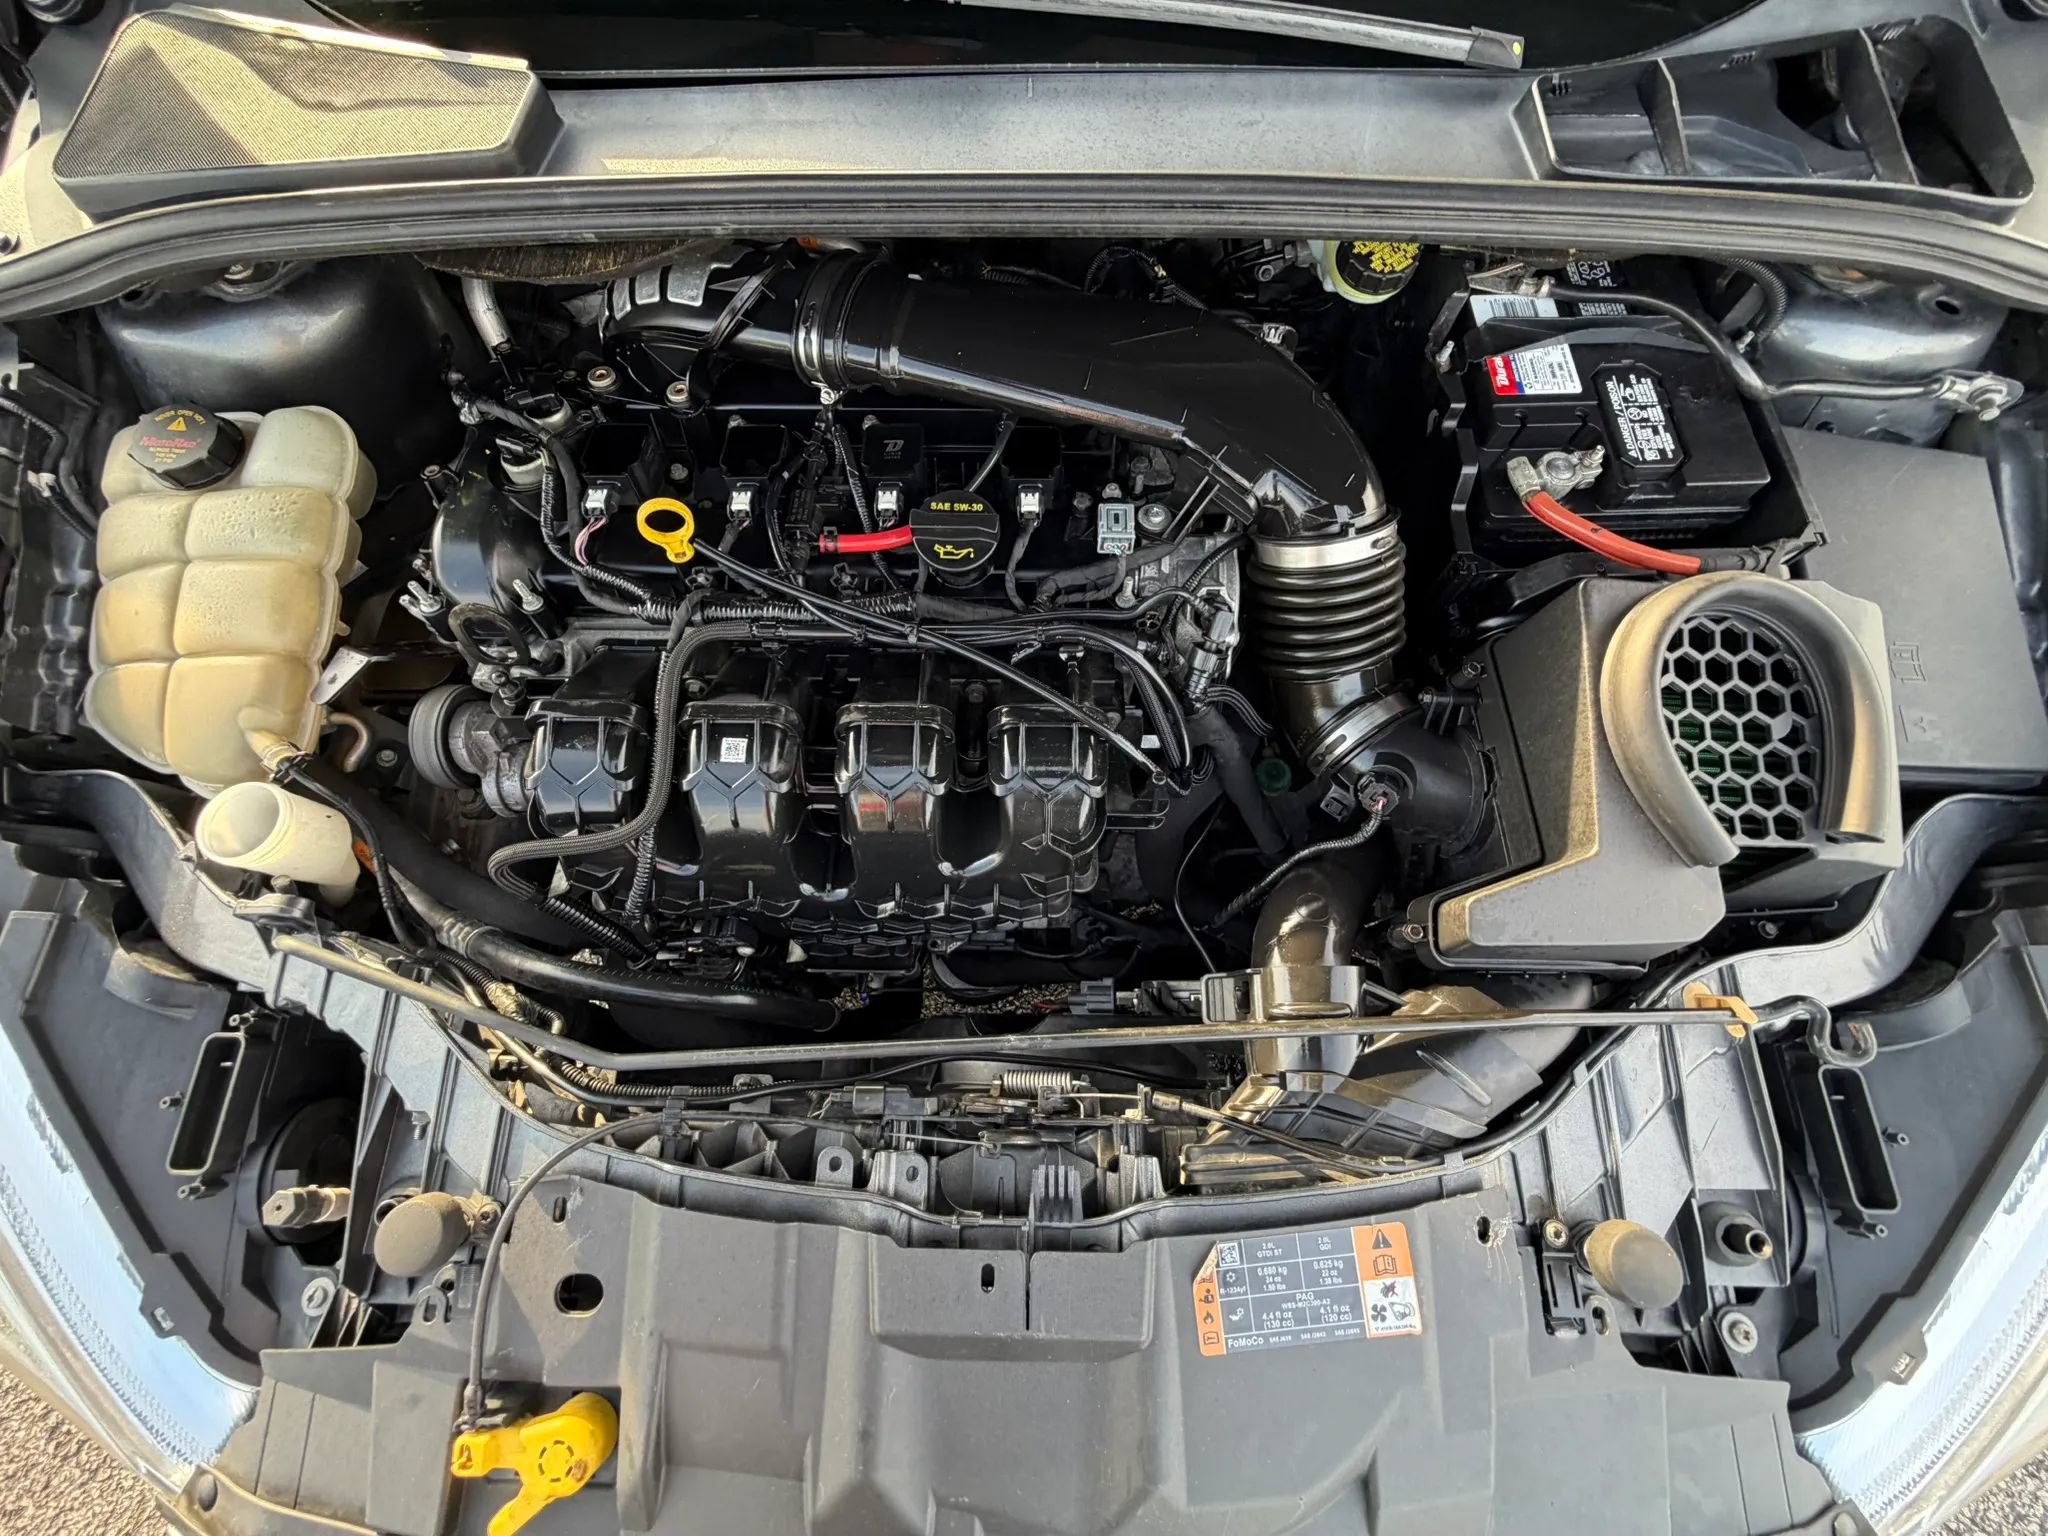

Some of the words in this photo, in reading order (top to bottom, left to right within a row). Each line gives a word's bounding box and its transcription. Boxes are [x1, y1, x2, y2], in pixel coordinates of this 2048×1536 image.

[1605, 381, 1623, 410] POISON
[1617, 416, 1636, 450] DANGER
[930, 501, 951, 511] SAE
[953, 502, 984, 511] 5W-30
[1333, 1259, 1344, 1269] kg
[1277, 1265, 1288, 1276] kg
[1295, 1291, 1315, 1301] PAG
[1319, 1305, 1331, 1314] 4.1
[1332, 1304, 1339, 1313] fl
[1340, 1304, 1351, 1312] oz
[1261, 1312, 1274, 1320] 4.4
[1275, 1311, 1281, 1320] fl
[1282, 1311, 1292, 1319] oz
[1321, 1313, 1339, 1325] (120
[1339, 1312, 1353, 1321] cc)
[1263, 1319, 1281, 1332] (130
[1282, 1318, 1295, 1328] cc)
[1227, 1335, 1264, 1349] FoMoCo
